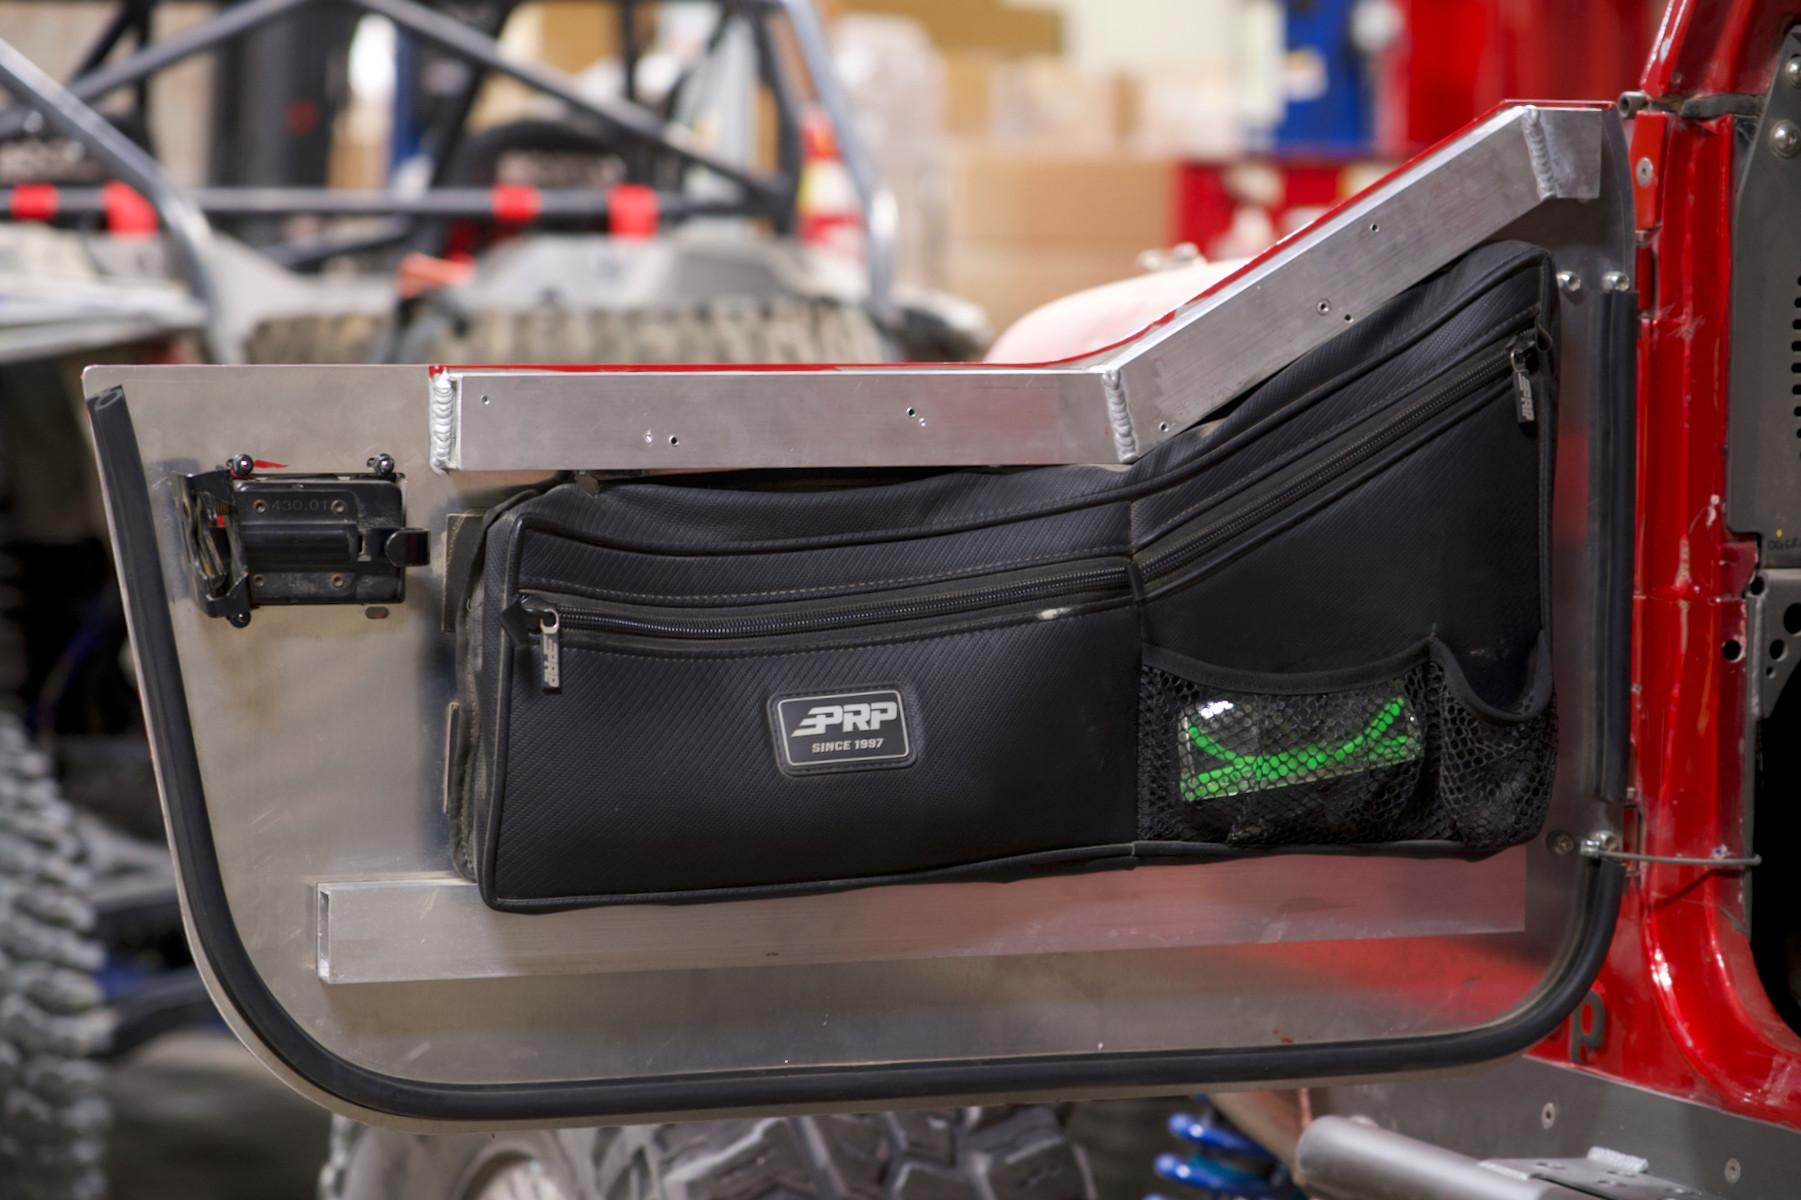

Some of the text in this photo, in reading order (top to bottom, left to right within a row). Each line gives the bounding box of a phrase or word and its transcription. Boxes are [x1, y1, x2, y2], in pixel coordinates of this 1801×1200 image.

[1517, 372, 1535, 421] PRP
[271, 499, 328, 512] 430.01
[543, 633, 560, 688] PRP
[791, 701, 898, 737] PRP
[811, 738, 884, 753] SINCE 1997
